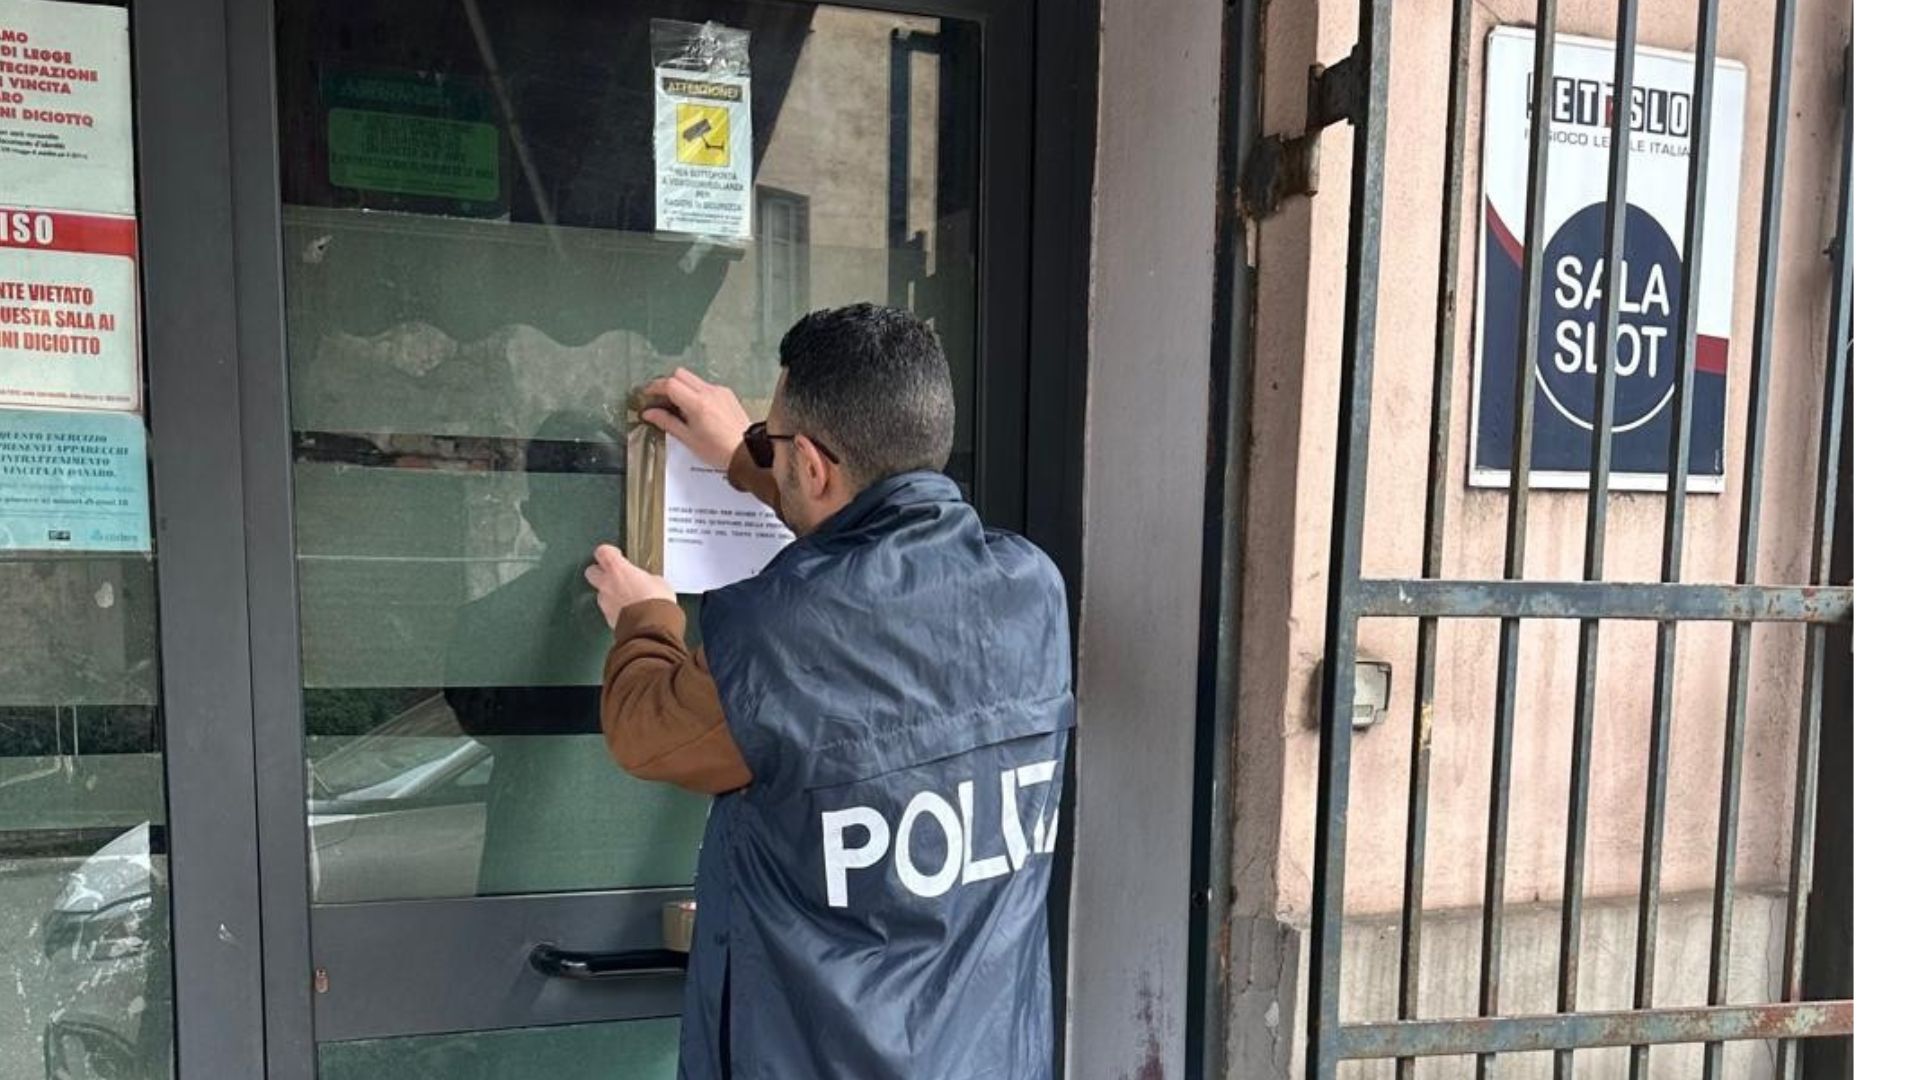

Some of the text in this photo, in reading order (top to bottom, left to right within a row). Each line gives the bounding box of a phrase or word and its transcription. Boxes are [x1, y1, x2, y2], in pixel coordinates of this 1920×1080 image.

[0, 30, 28, 44] MO
[23, 48, 72, 64] LEGGE
[9, 78, 71, 94] VINCITA
[0, 91, 23, 104] RO
[29, 284, 93, 305] VIETATO
[1555, 255, 1669, 316] SALA
[55, 310, 95, 330] SALA
[99, 313, 115, 332] AI
[23, 332, 100, 355] DICIOTTO
[1555, 319, 1667, 378] SLOT
